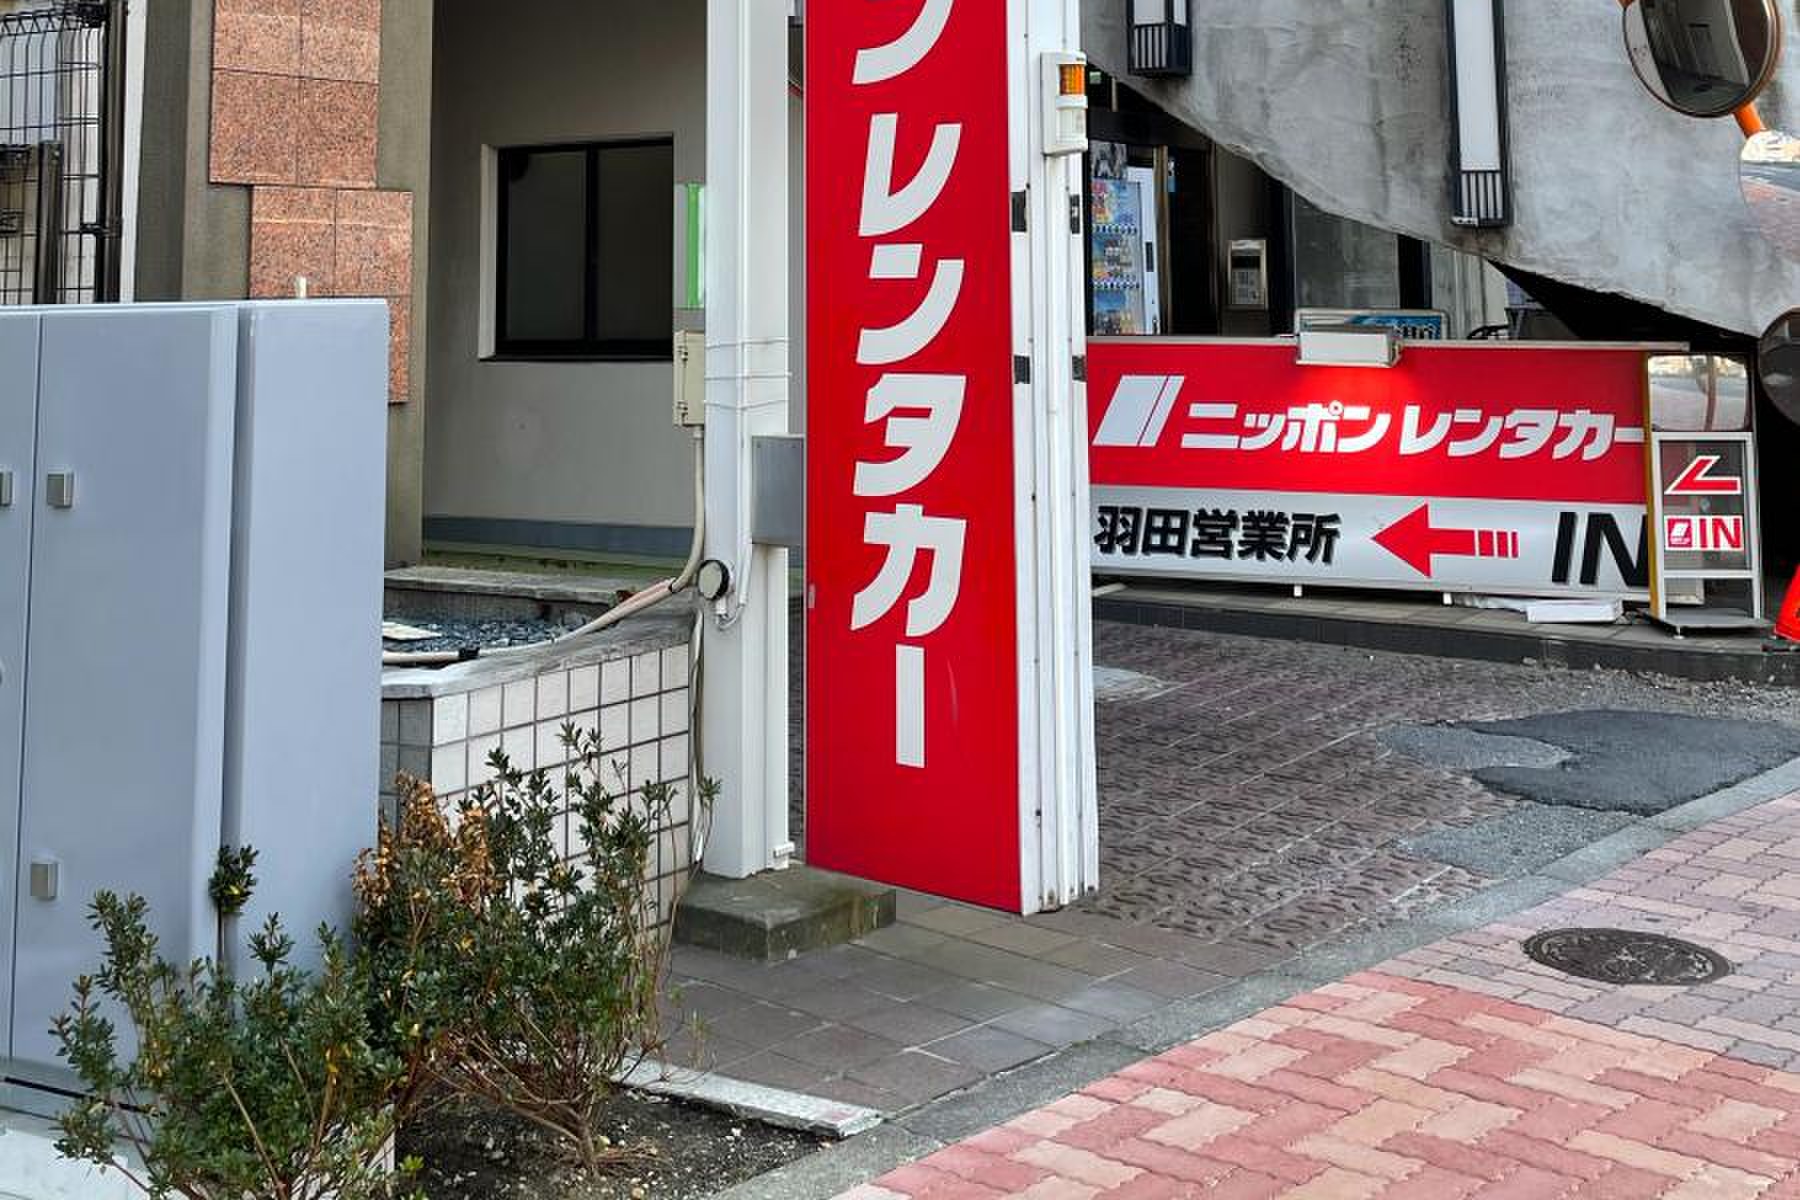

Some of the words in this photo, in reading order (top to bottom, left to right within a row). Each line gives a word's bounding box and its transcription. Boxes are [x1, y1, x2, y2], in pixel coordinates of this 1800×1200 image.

[1181, 400, 1645, 461] ニッポンレンタカー
[1094, 506, 1343, 565] 羽田営業所
[1551, 511, 1648, 588] IN
[1699, 518, 1741, 549] IN
